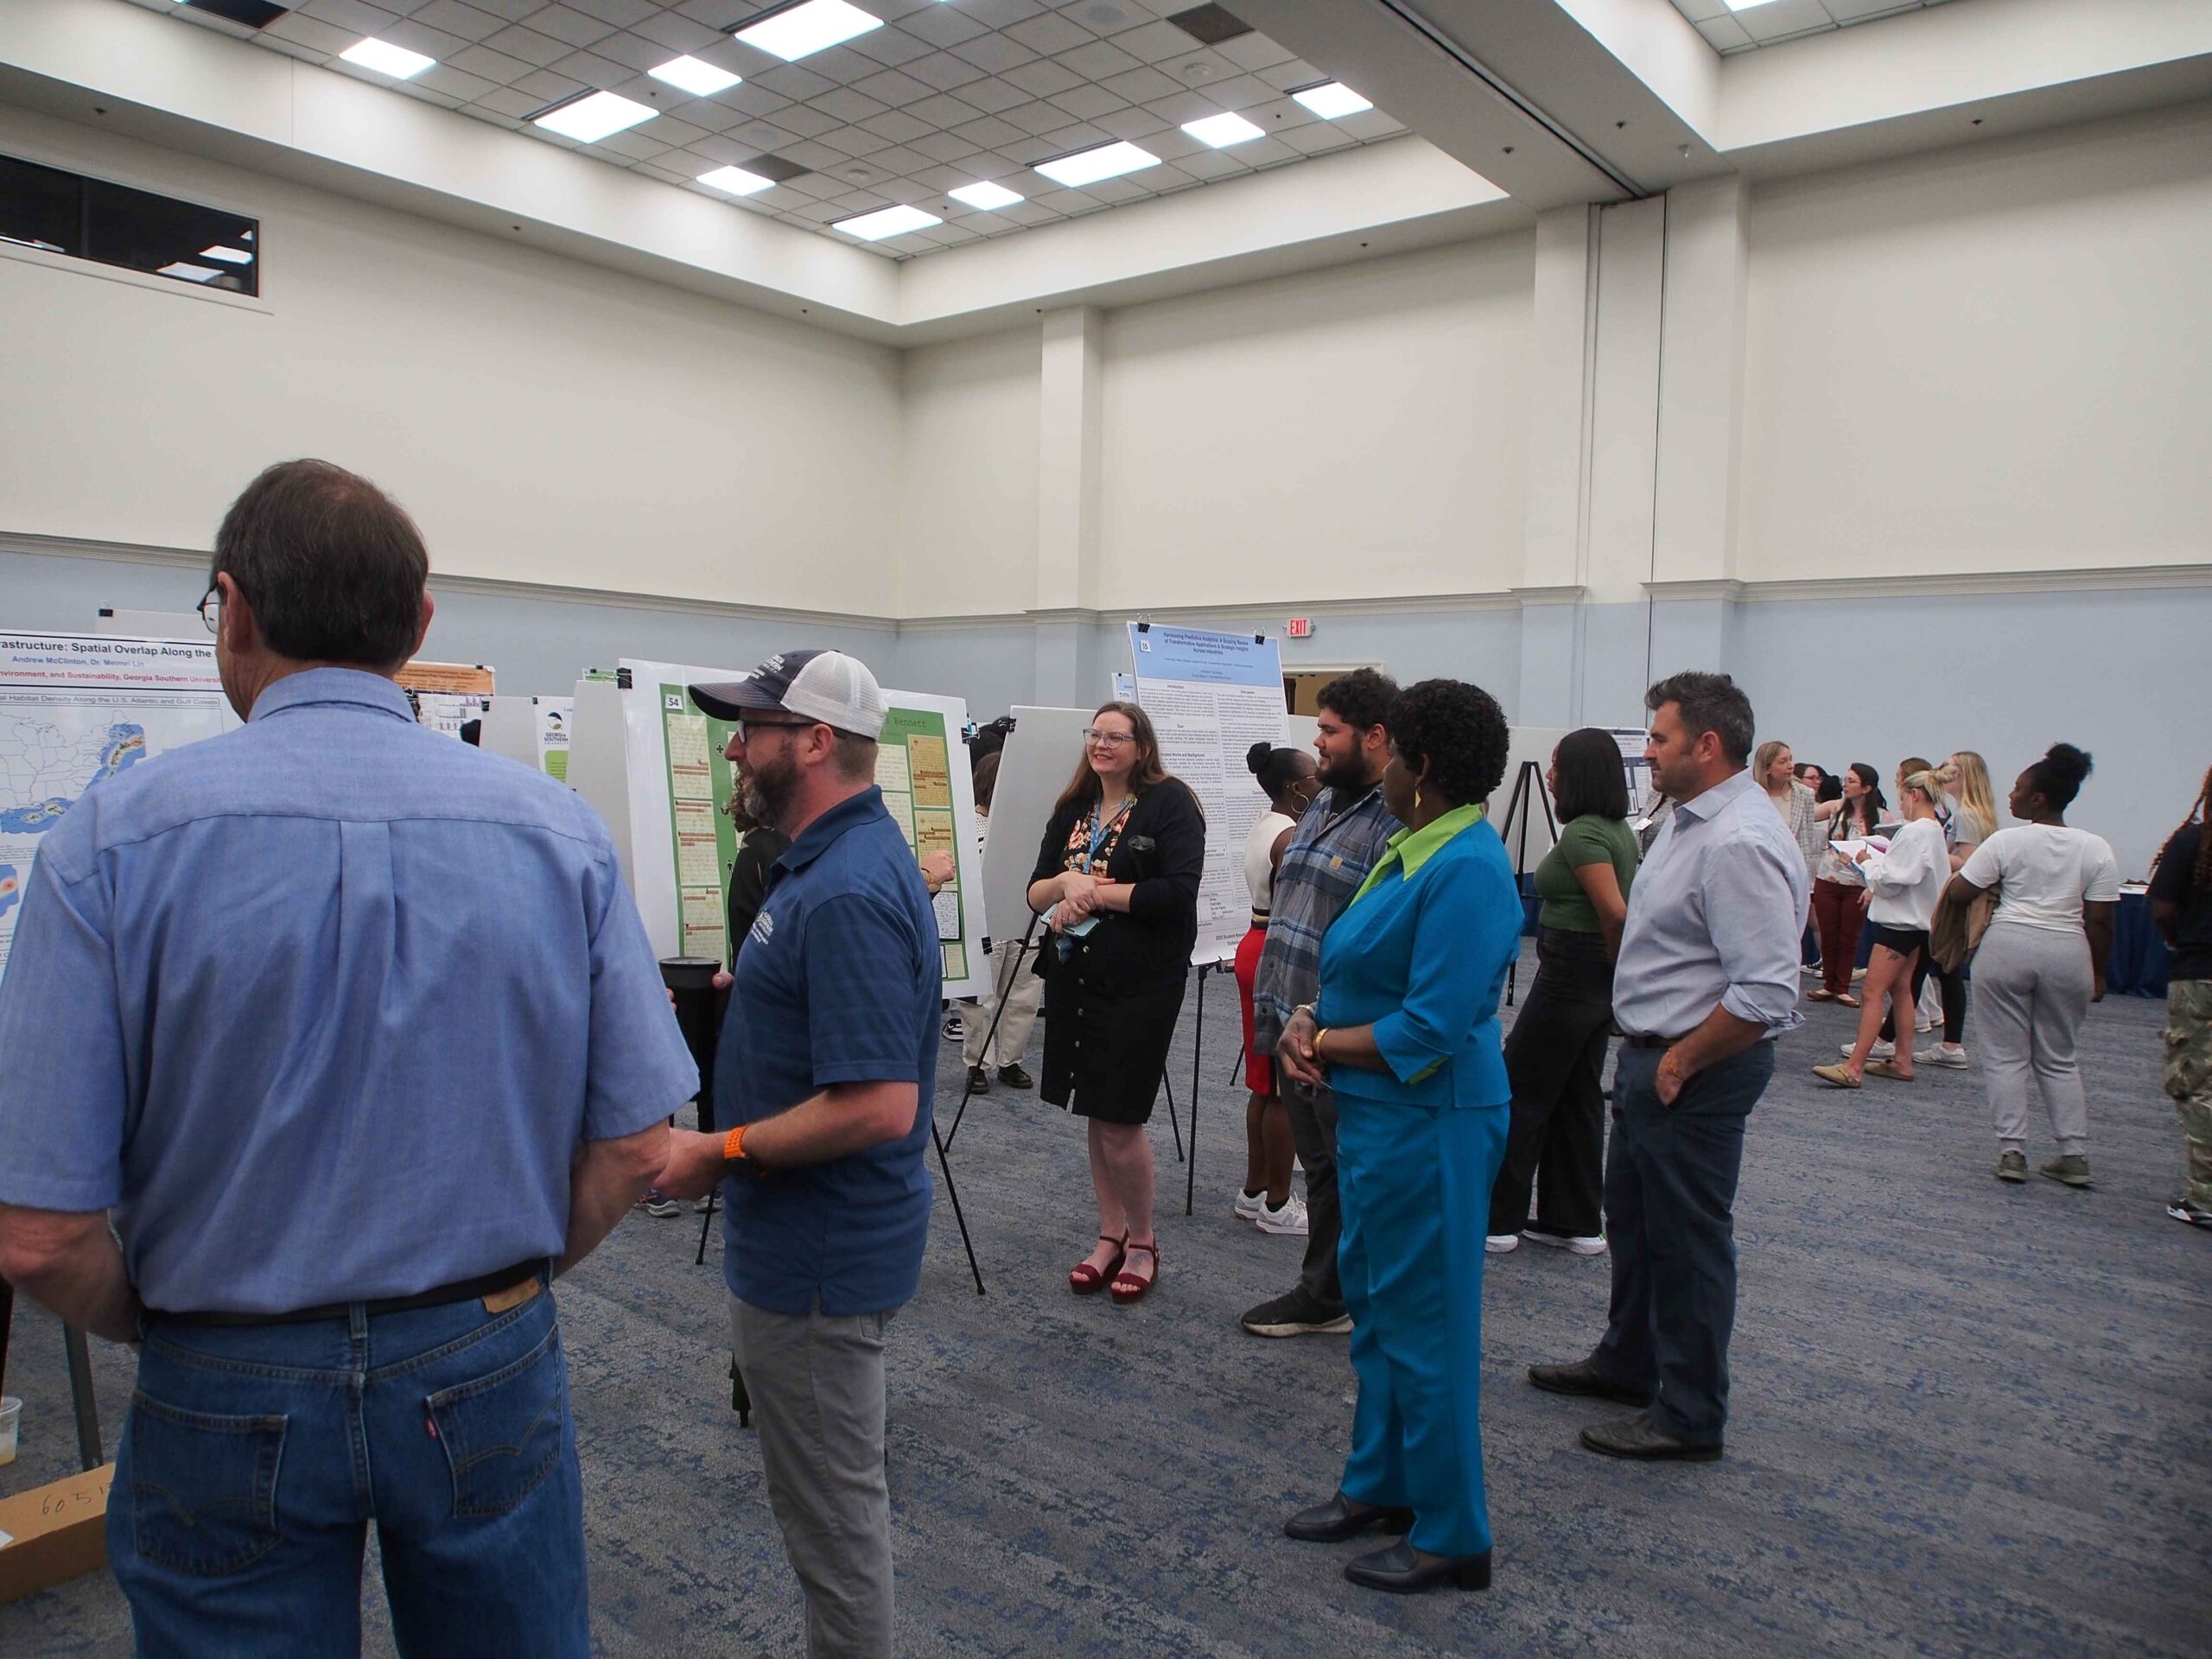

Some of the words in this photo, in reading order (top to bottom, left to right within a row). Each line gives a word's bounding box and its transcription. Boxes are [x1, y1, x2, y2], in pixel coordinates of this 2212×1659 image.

[1290, 620, 1307, 635] EXIT
[72, 643, 111, 653] Spatial
[114, 645, 158, 657] Overlap
[161, 647, 192, 658] Along
[195, 649, 212, 658] the
[67, 671, 121, 681] Sustainability,
[73, 696, 96, 704] Along
[669, 697, 679, 707] 54
[893, 717, 926, 728] Bennett
